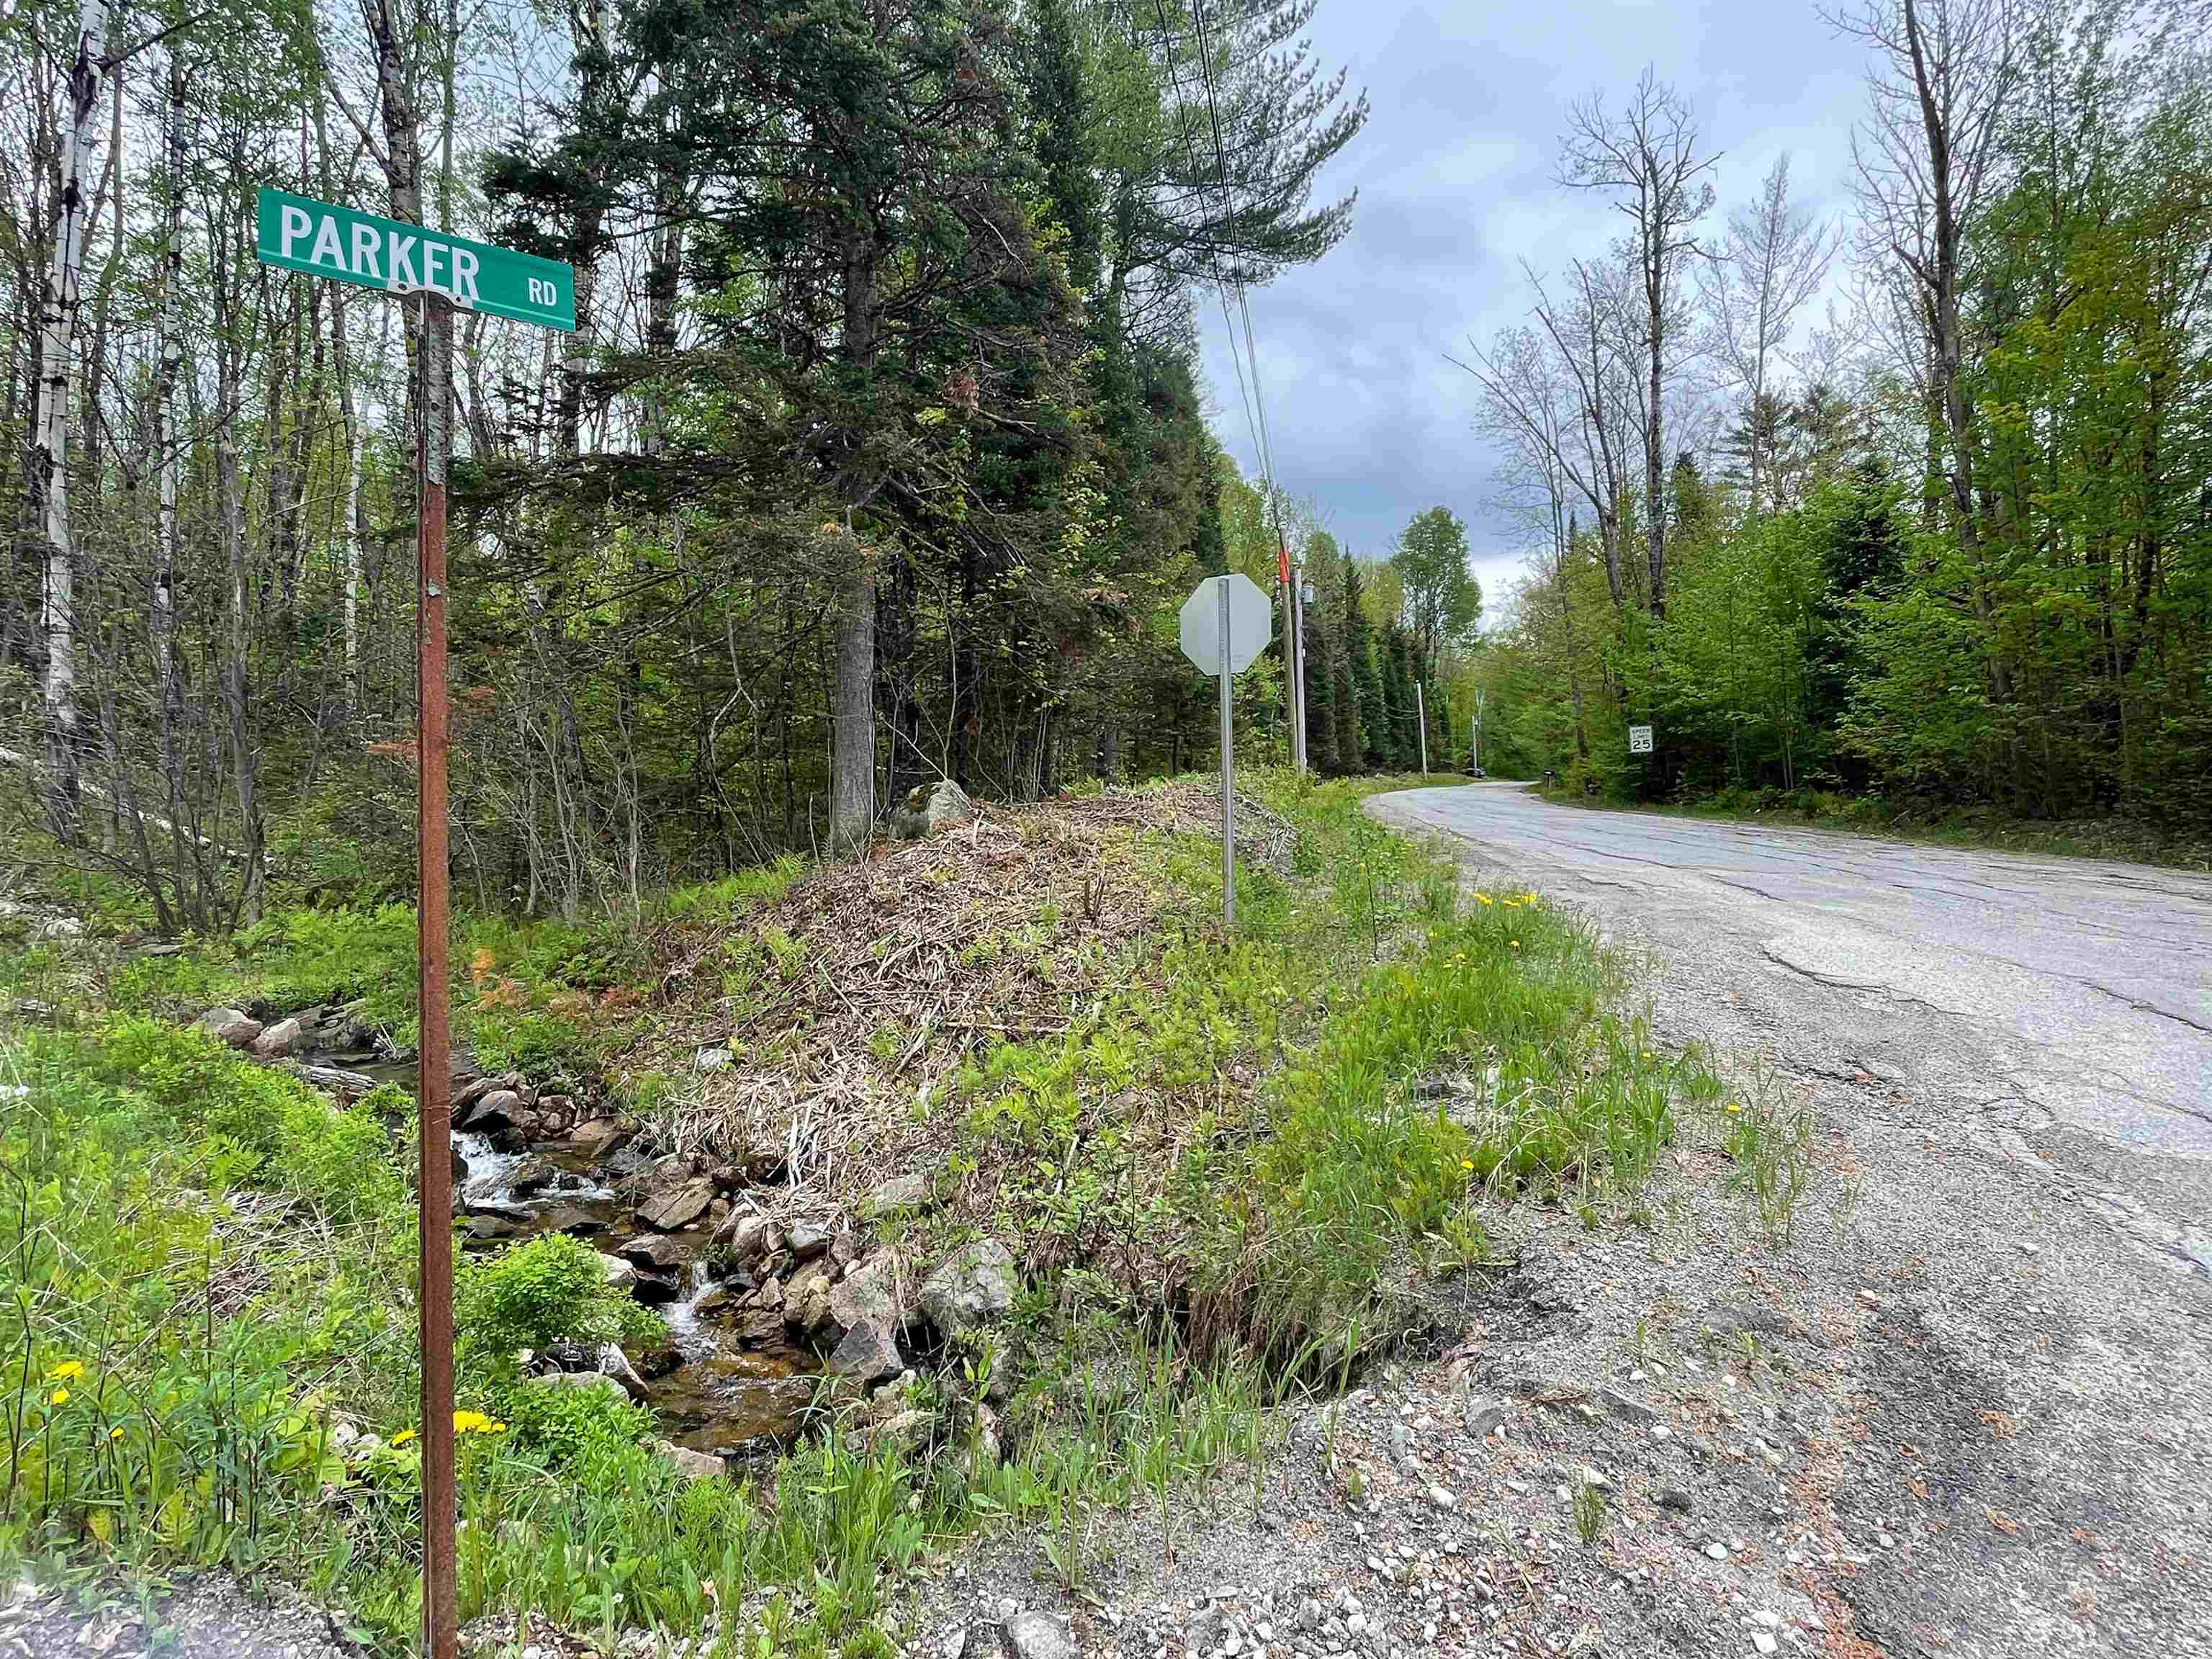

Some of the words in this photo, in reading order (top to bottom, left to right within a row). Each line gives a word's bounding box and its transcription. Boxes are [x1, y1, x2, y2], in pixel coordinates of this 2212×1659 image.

[280, 204, 480, 301] PARKER
[529, 277, 557, 307] RD
[1632, 739, 1650, 750] 25
